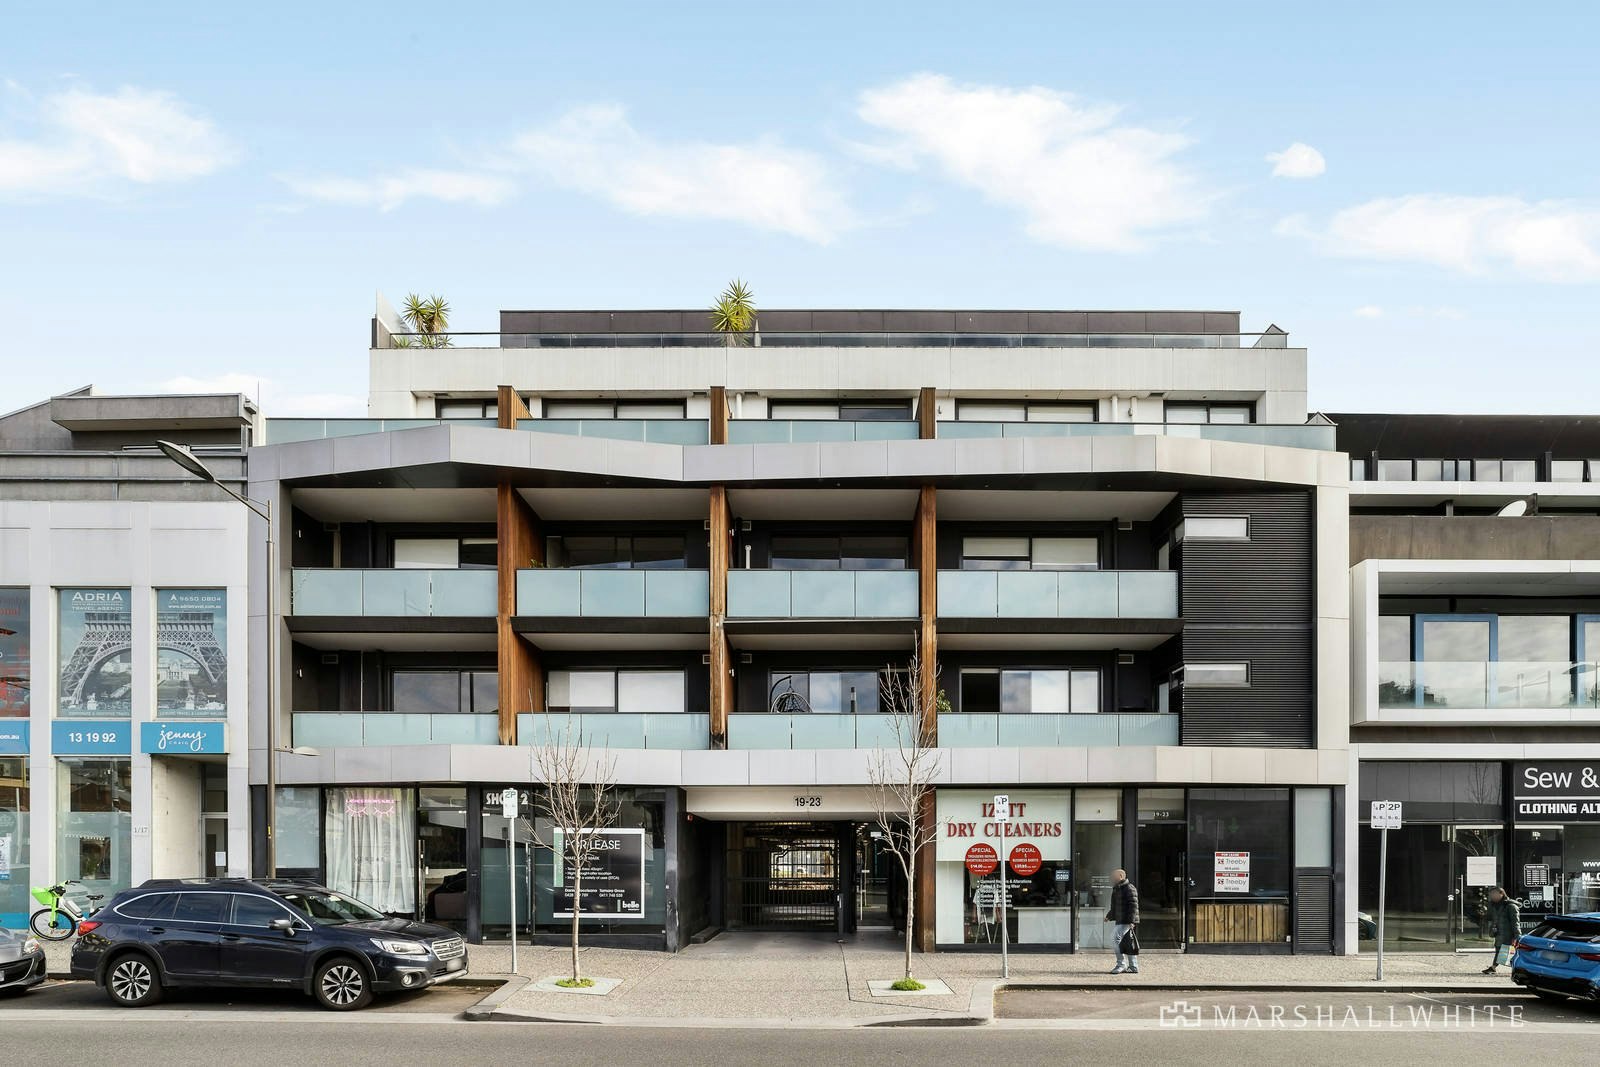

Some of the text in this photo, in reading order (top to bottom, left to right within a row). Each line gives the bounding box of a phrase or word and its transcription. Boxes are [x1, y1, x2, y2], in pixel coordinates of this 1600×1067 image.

[72, 592, 123, 601] ADRIA
[69, 732, 116, 743] 13 19 92
[158, 724, 207, 752] jenny
[1524, 767, 1600, 788] Sew &
[504, 791, 517, 799] 2P
[520, 793, 529, 805] 2
[794, 797, 821, 807] 19-23
[1387, 803, 1401, 811] 2P
[982, 802, 1027, 818] IZTT
[1519, 803, 1578, 815] CLOTHING
[947, 822, 1063, 838] DRY CLEANERS
[589, 839, 621, 850] LEASE
[1225, 858, 1247, 866] Treeby
[1225, 878, 1247, 886] Treeby
[622, 900, 640, 909] belle
[1515, 897, 1540, 909] Sew
